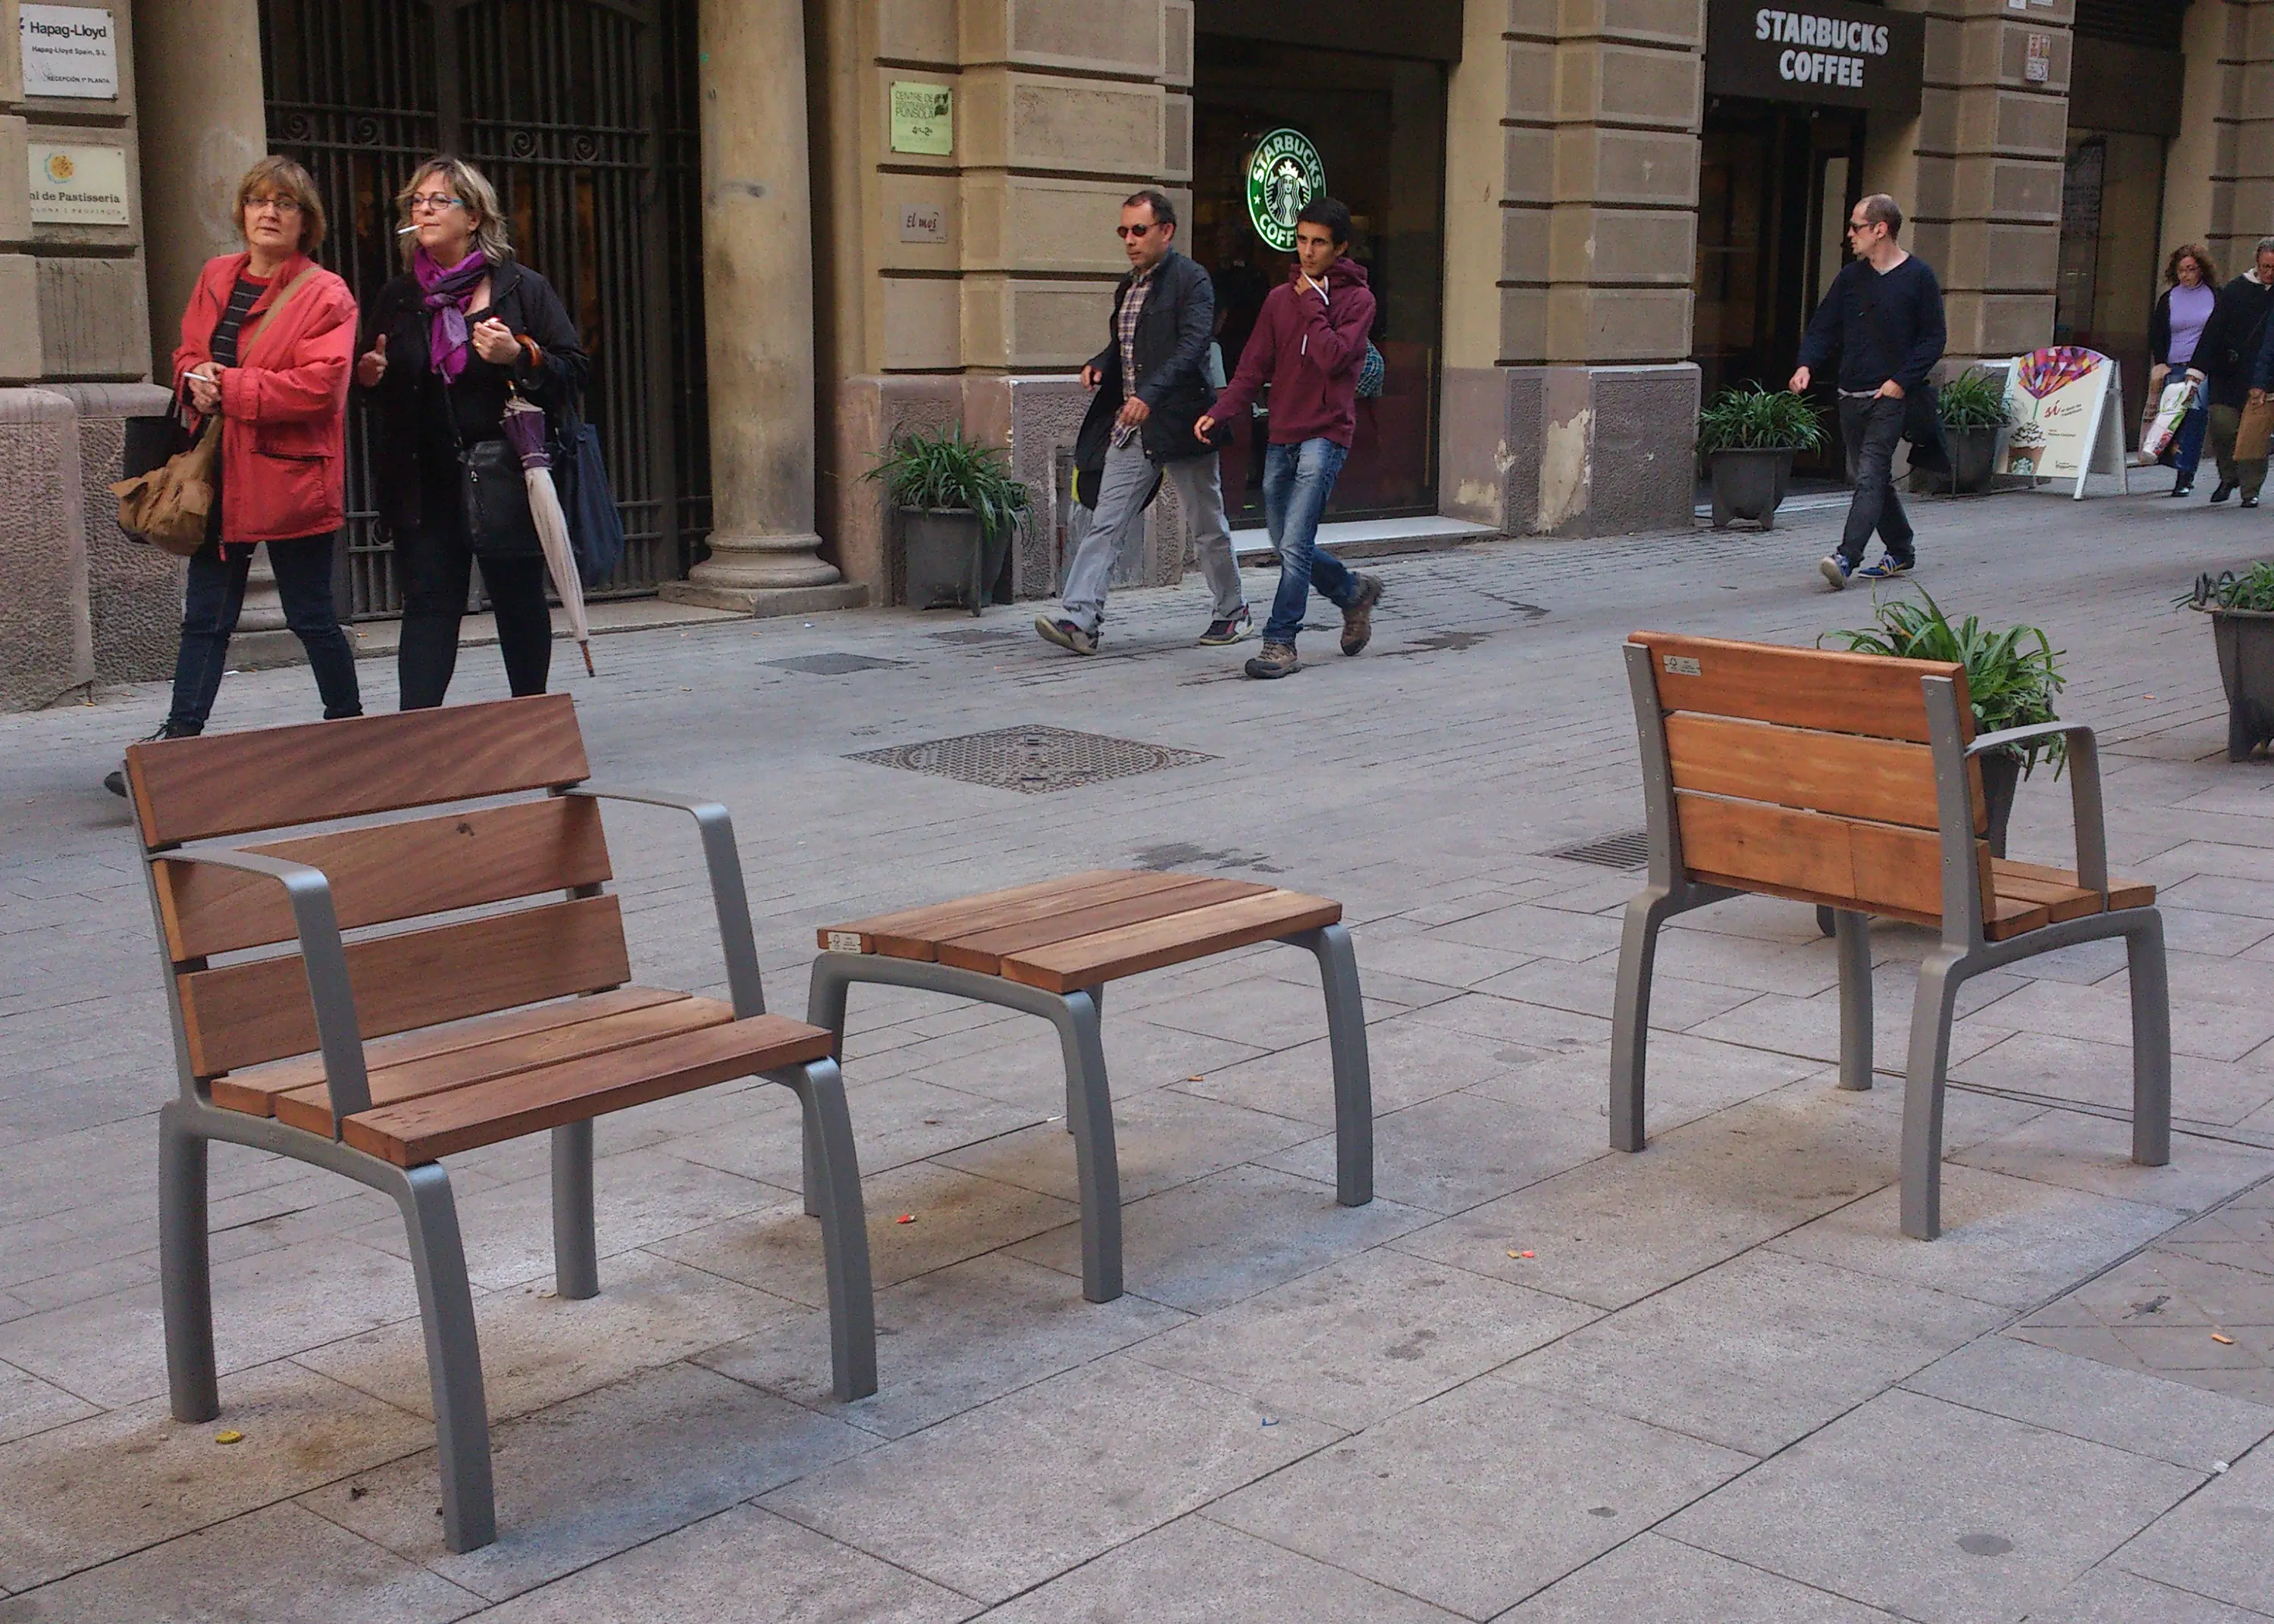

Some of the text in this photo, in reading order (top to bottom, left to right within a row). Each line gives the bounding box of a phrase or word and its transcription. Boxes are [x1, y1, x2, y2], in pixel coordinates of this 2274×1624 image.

[30, 21, 106, 39] Hapag-Lloyd
[1756, 8, 1889, 55] STARBUCKS
[32, 45, 73, 55] Hapag-Lloyd
[74, 48, 95, 56] Spain,
[1780, 49, 1865, 87] COFFEE
[895, 91, 933, 102] CENTRE DE
[1252, 135, 1322, 189] STARBUCKS
[42, 191, 56, 201] de
[58, 192, 121, 204] Pastisseria
[906, 212, 916, 228] El
[1259, 213, 1295, 246] COFF
[2044, 399, 2062, 418] sí
